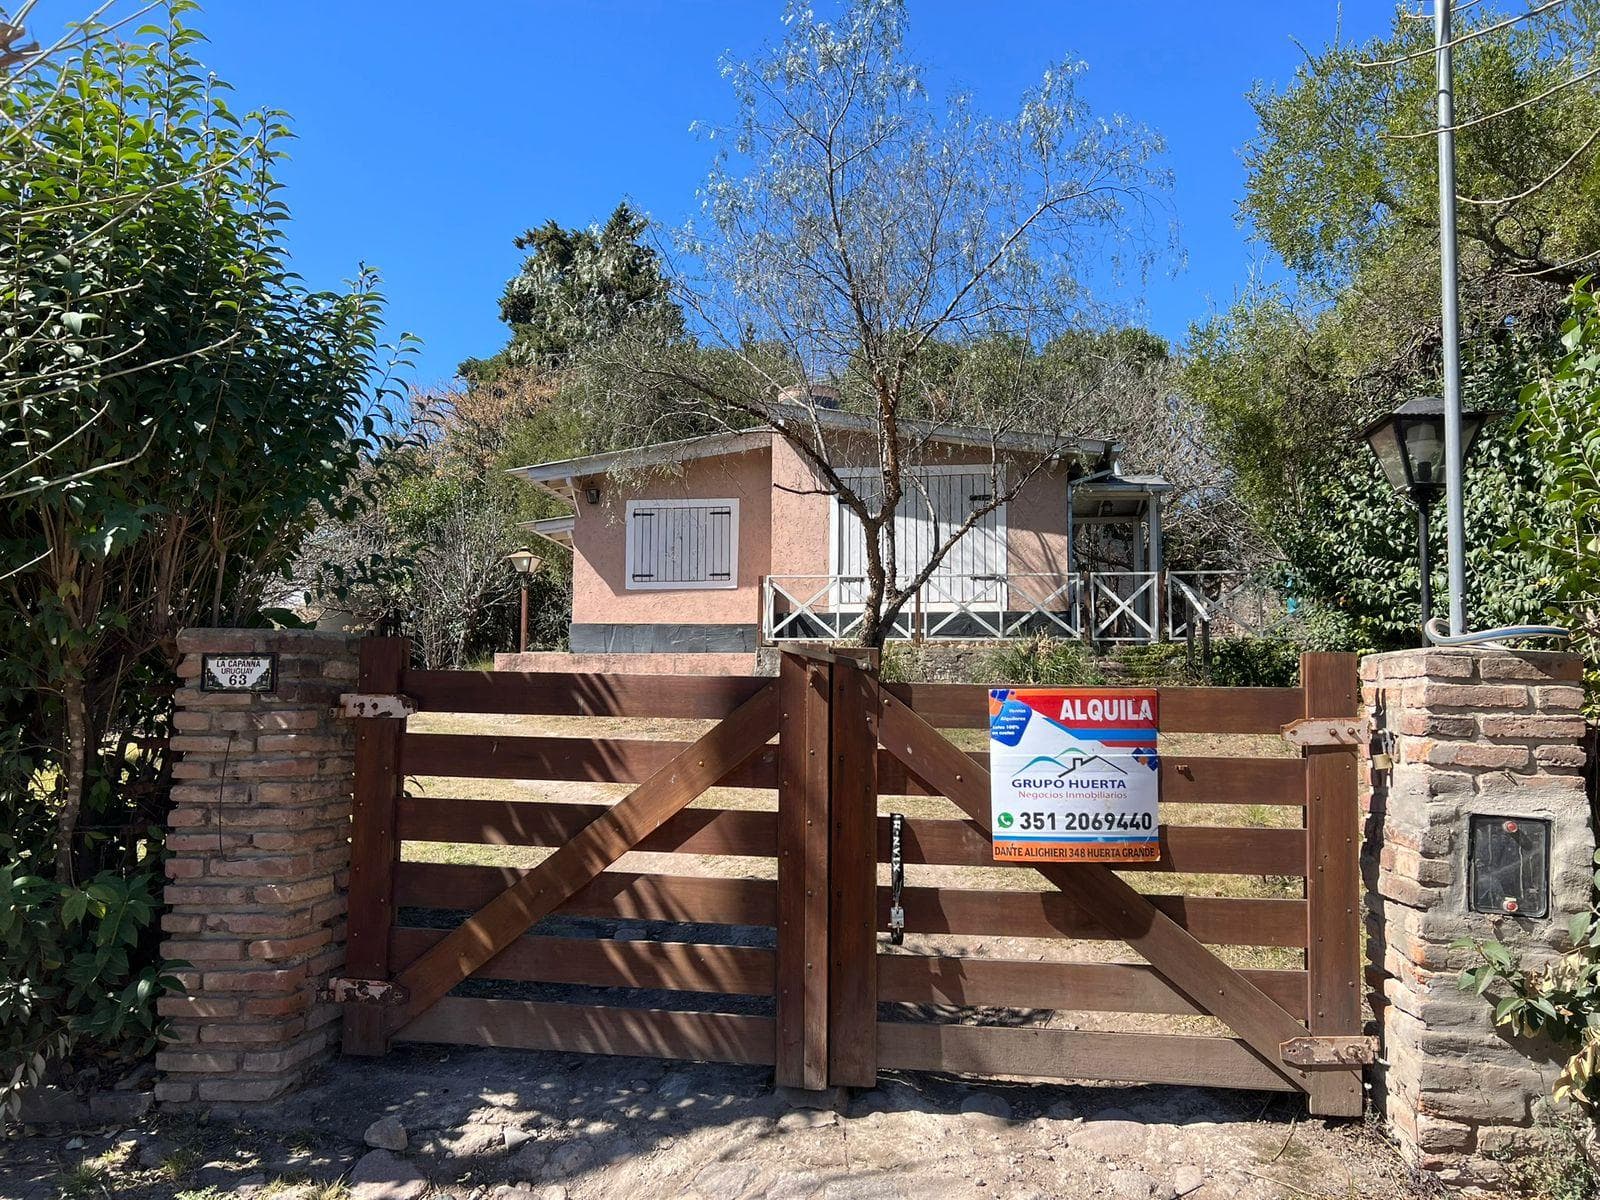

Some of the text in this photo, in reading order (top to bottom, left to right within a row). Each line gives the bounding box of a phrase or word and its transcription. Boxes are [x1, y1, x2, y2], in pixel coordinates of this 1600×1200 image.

[229, 674, 247, 686] 63
[1059, 699, 1153, 722] ALQUILA
[1011, 778, 1127, 789] GRUPO HUERTA
[1018, 790, 1128, 800] Negocios Inmobiliarios
[1019, 812, 1152, 831] 351 2069440
[994, 846, 1155, 858] DANTE ALIGHIERI 348 HUERTA GRANDE
